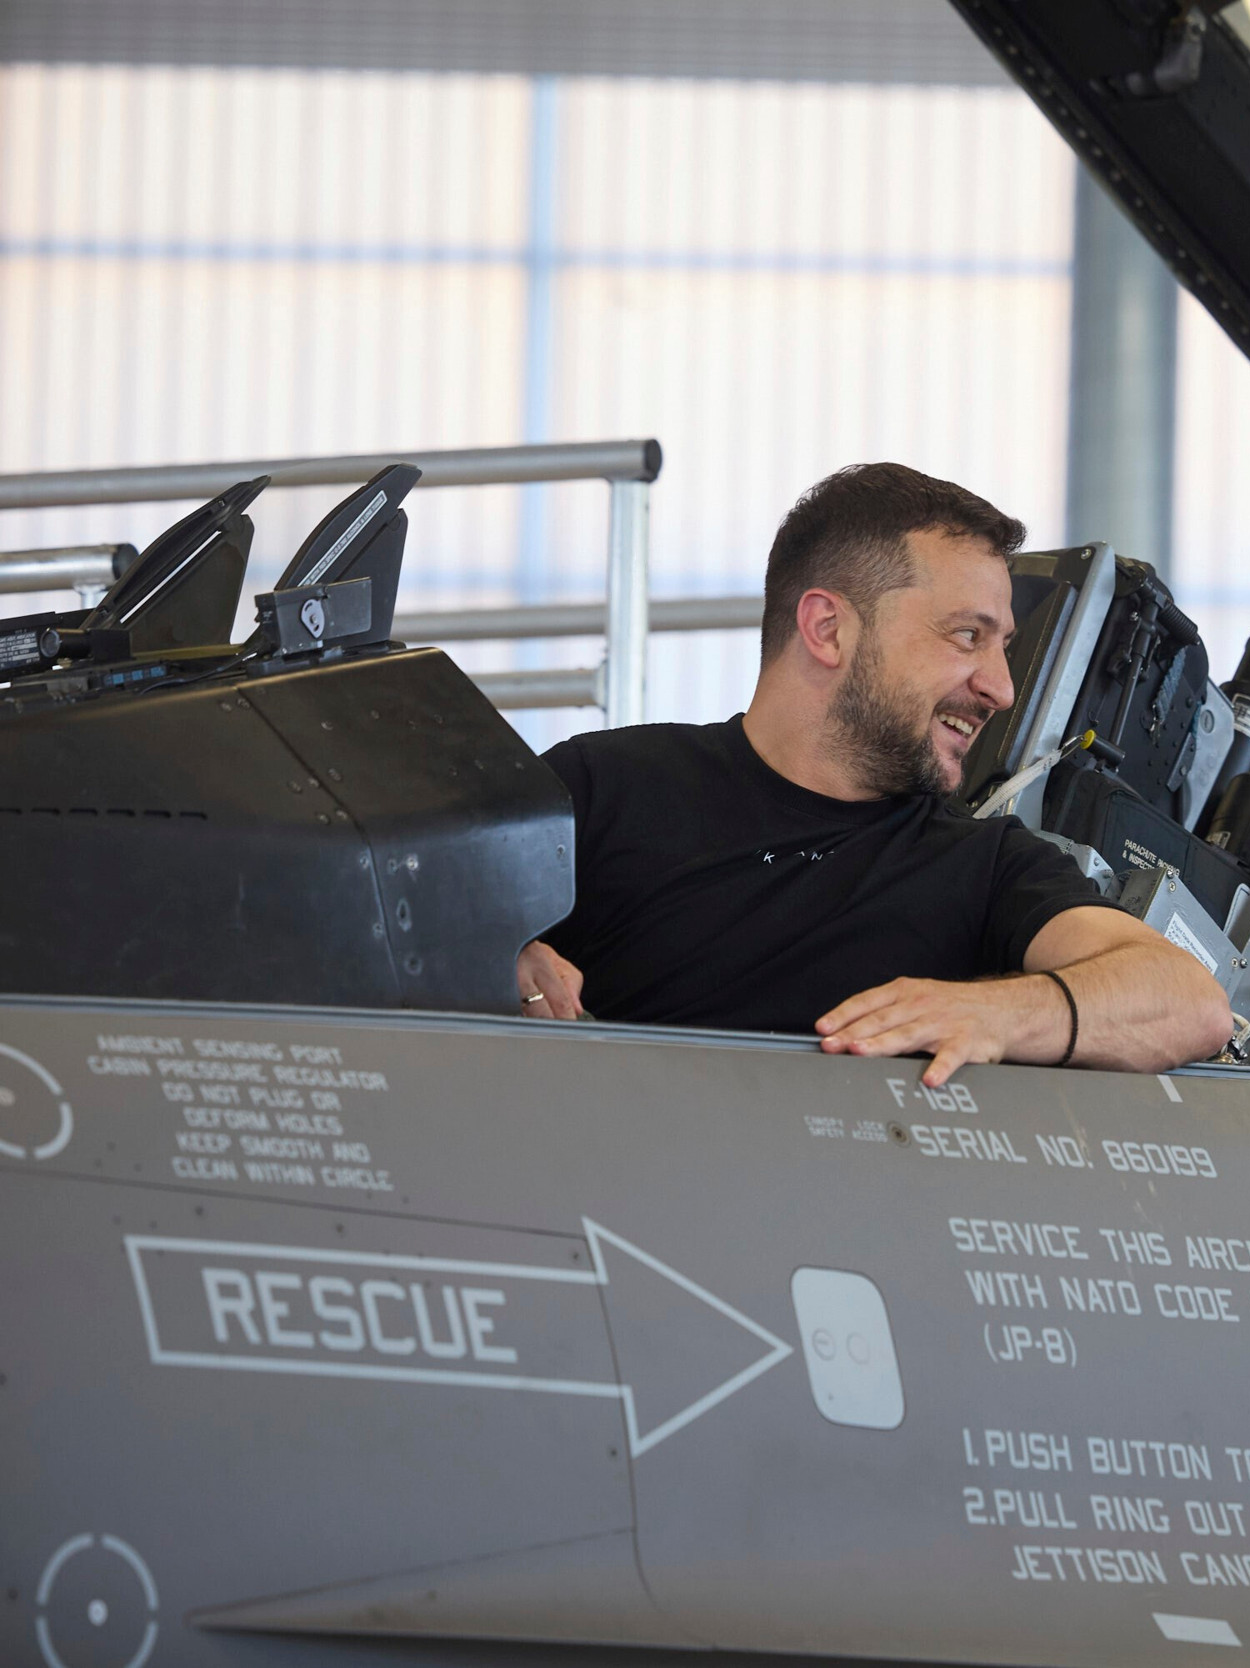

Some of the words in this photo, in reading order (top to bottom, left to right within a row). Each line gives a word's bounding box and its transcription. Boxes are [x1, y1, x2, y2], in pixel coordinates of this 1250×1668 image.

[1122, 850, 1127, 859] &
[1125, 839, 1157, 864] PARACHUTE
[97, 1034, 184, 1054] AMBIENT
[193, 1039, 283, 1061] SENSING
[290, 1045, 342, 1064] PORT
[88, 1055, 151, 1075] CABIN
[156, 1059, 268, 1082] PRESSURE
[273, 1065, 388, 1091] REGULATOR
[162, 1081, 194, 1101] DO
[200, 1085, 239, 1104] NOT
[248, 1087, 304, 1108] PLUG
[183, 1107, 270, 1130] DEFORM
[275, 1113, 343, 1136] HOLES
[176, 1131, 231, 1154] KEEP
[239, 1135, 323, 1160] SMOOTH
[332, 1142, 370, 1163] AND
[910, 1124, 1027, 1163] SERIAL
[1035, 1133, 1093, 1168] NO.
[1102, 1139, 1218, 1177] 860199
[172, 1156, 238, 1181] CLEAN
[244, 1161, 314, 1185] WITHIN
[321, 1166, 394, 1191] CIRCLE
[948, 1217, 1088, 1260] SERVICE
[1100, 1228, 1172, 1266] THIS
[965, 1270, 1048, 1309] WITH
[1059, 1277, 1142, 1316] NATO
[1153, 1284, 1240, 1322] CODE
[201, 1267, 518, 1364] RESCUE
[983, 1323, 1077, 1367] (JP-8)
[1088, 1436, 1212, 1481] BUTTON
[1091, 1495, 1170, 1533] RING
[1185, 1500, 1246, 1537] OUT
[1012, 1545, 1167, 1584] JETTISON
